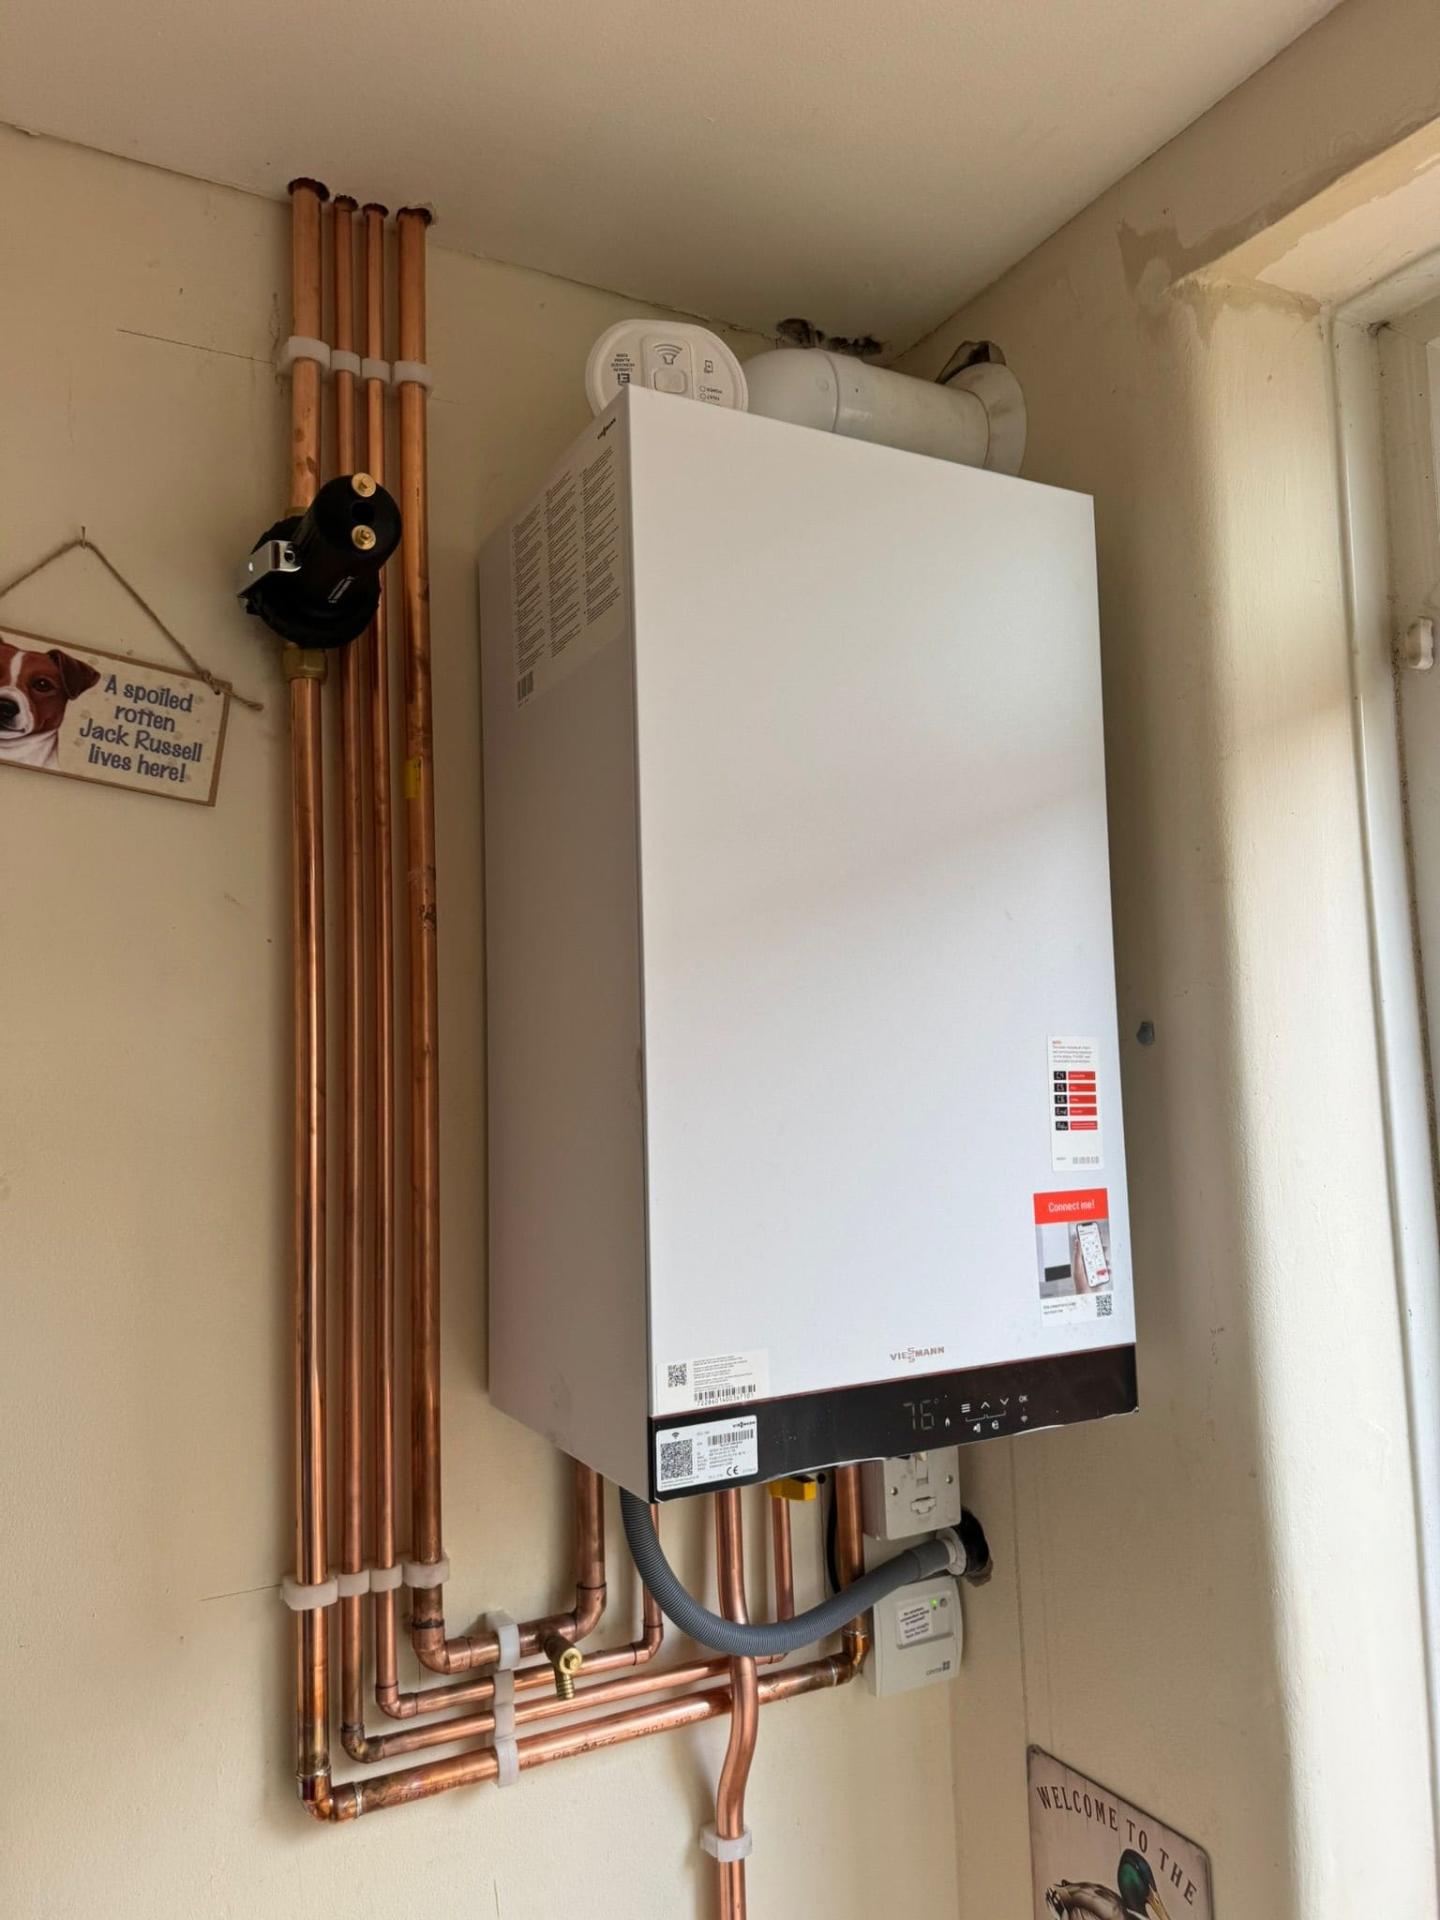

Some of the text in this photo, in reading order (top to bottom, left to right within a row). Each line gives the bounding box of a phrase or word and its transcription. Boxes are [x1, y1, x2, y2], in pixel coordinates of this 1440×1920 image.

[104, 674, 193, 713] A spoiled
[114, 705, 176, 732] rotten
[80, 719, 203, 762] Jack Russell
[88, 743, 186, 782] lives here!
[1048, 1199, 1095, 1213] Connect me!
[890, 1346, 945, 1363] VIESSMANN
[1036, 1785, 1198, 1906] WELCOME TO THE
